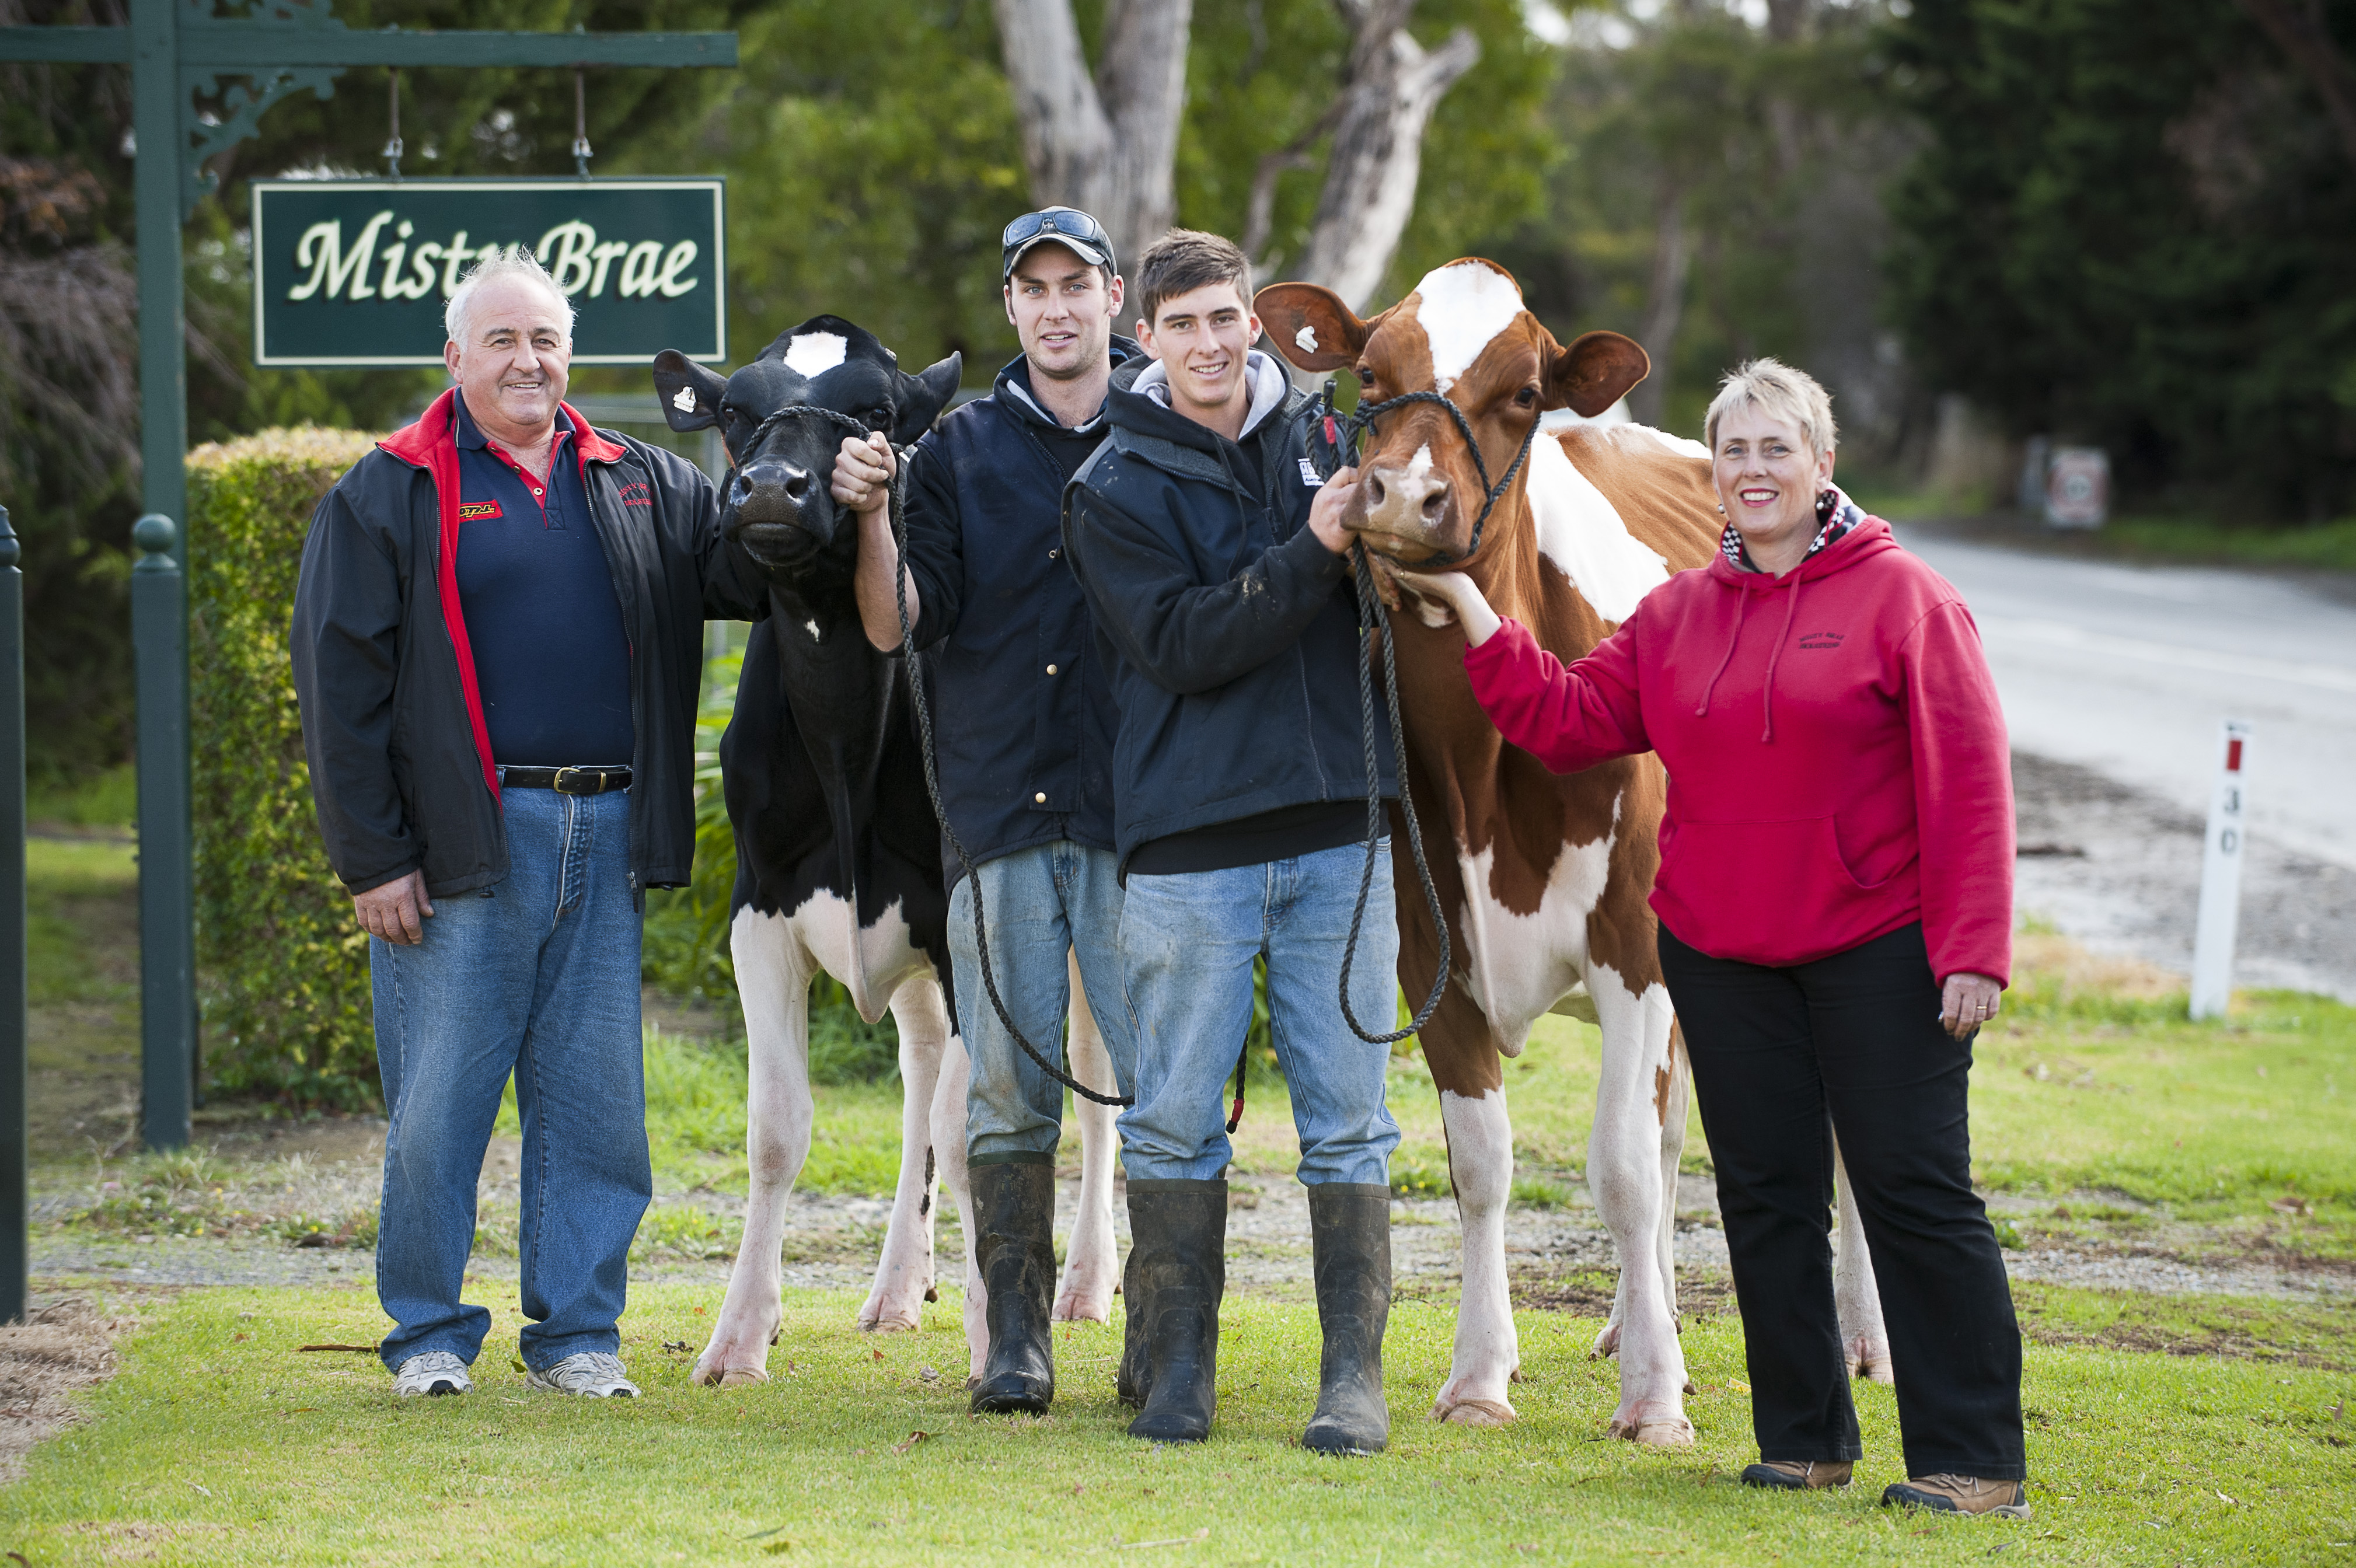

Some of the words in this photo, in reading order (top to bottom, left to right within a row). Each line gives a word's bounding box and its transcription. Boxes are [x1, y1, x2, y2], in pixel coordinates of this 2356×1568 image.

[288, 211, 519, 300] Mist
[537, 220, 698, 298] Brae
[460, 504, 495, 518] OTAL
